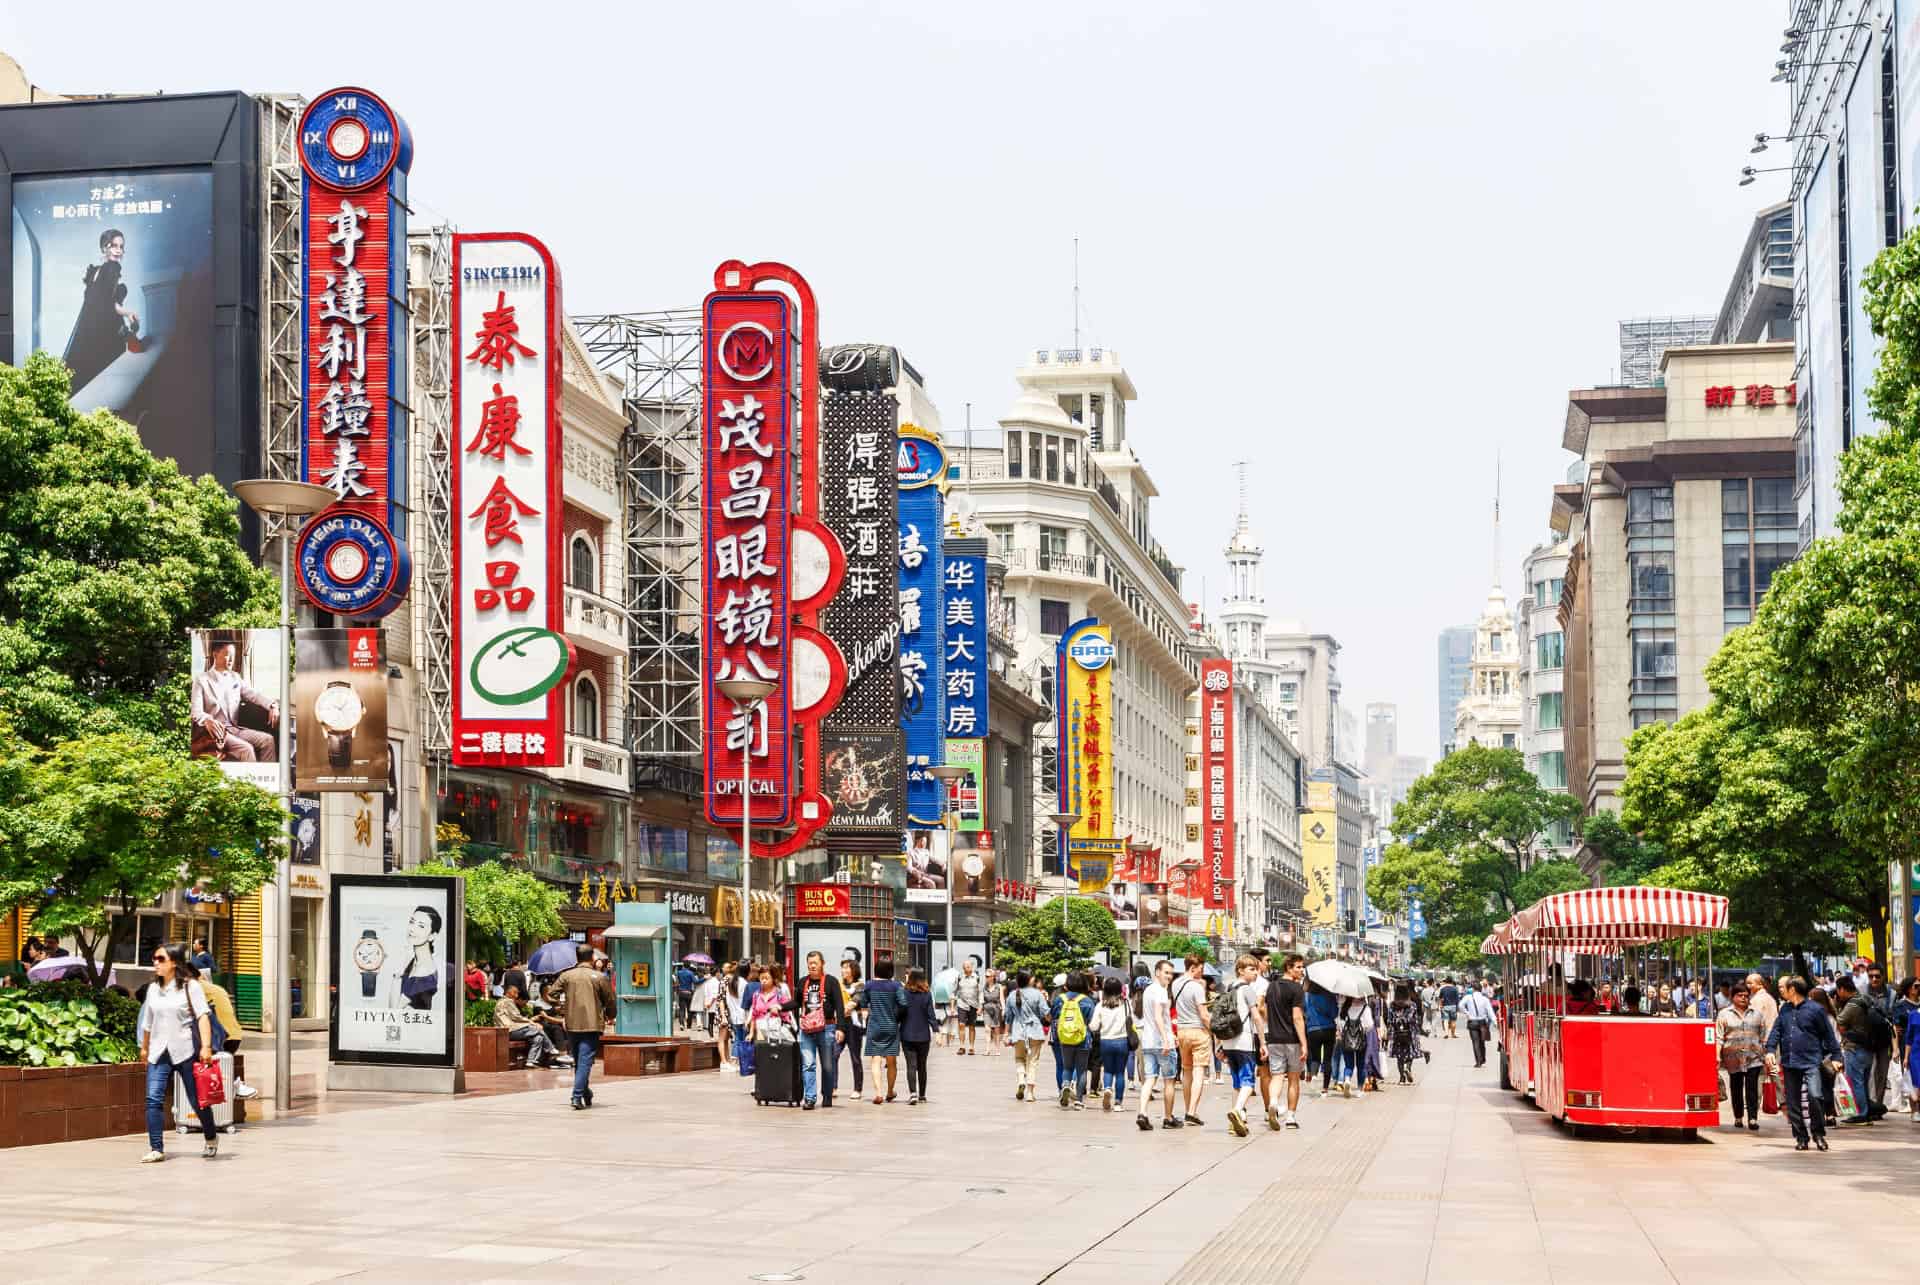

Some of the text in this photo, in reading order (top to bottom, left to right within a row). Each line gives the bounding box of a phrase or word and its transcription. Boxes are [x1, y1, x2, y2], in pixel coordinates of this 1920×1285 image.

[335, 97, 357, 110] XII
[304, 131, 321, 144] IX
[372, 131, 388, 144] III
[337, 165, 355, 178] VI
[464, 266, 540, 280] SINCE 1914
[465, 290, 541, 613] 泰康食品
[307, 518, 384, 550] HENG DALI
[715, 394, 779, 757] 茂昌眼镜公司
[945, 561, 976, 734] 华美大药房
[716, 779, 777, 795] OPTCAL
[805, 890, 823, 899] BUS
[354, 1010, 432, 1024] FIYTA 飞亚达
